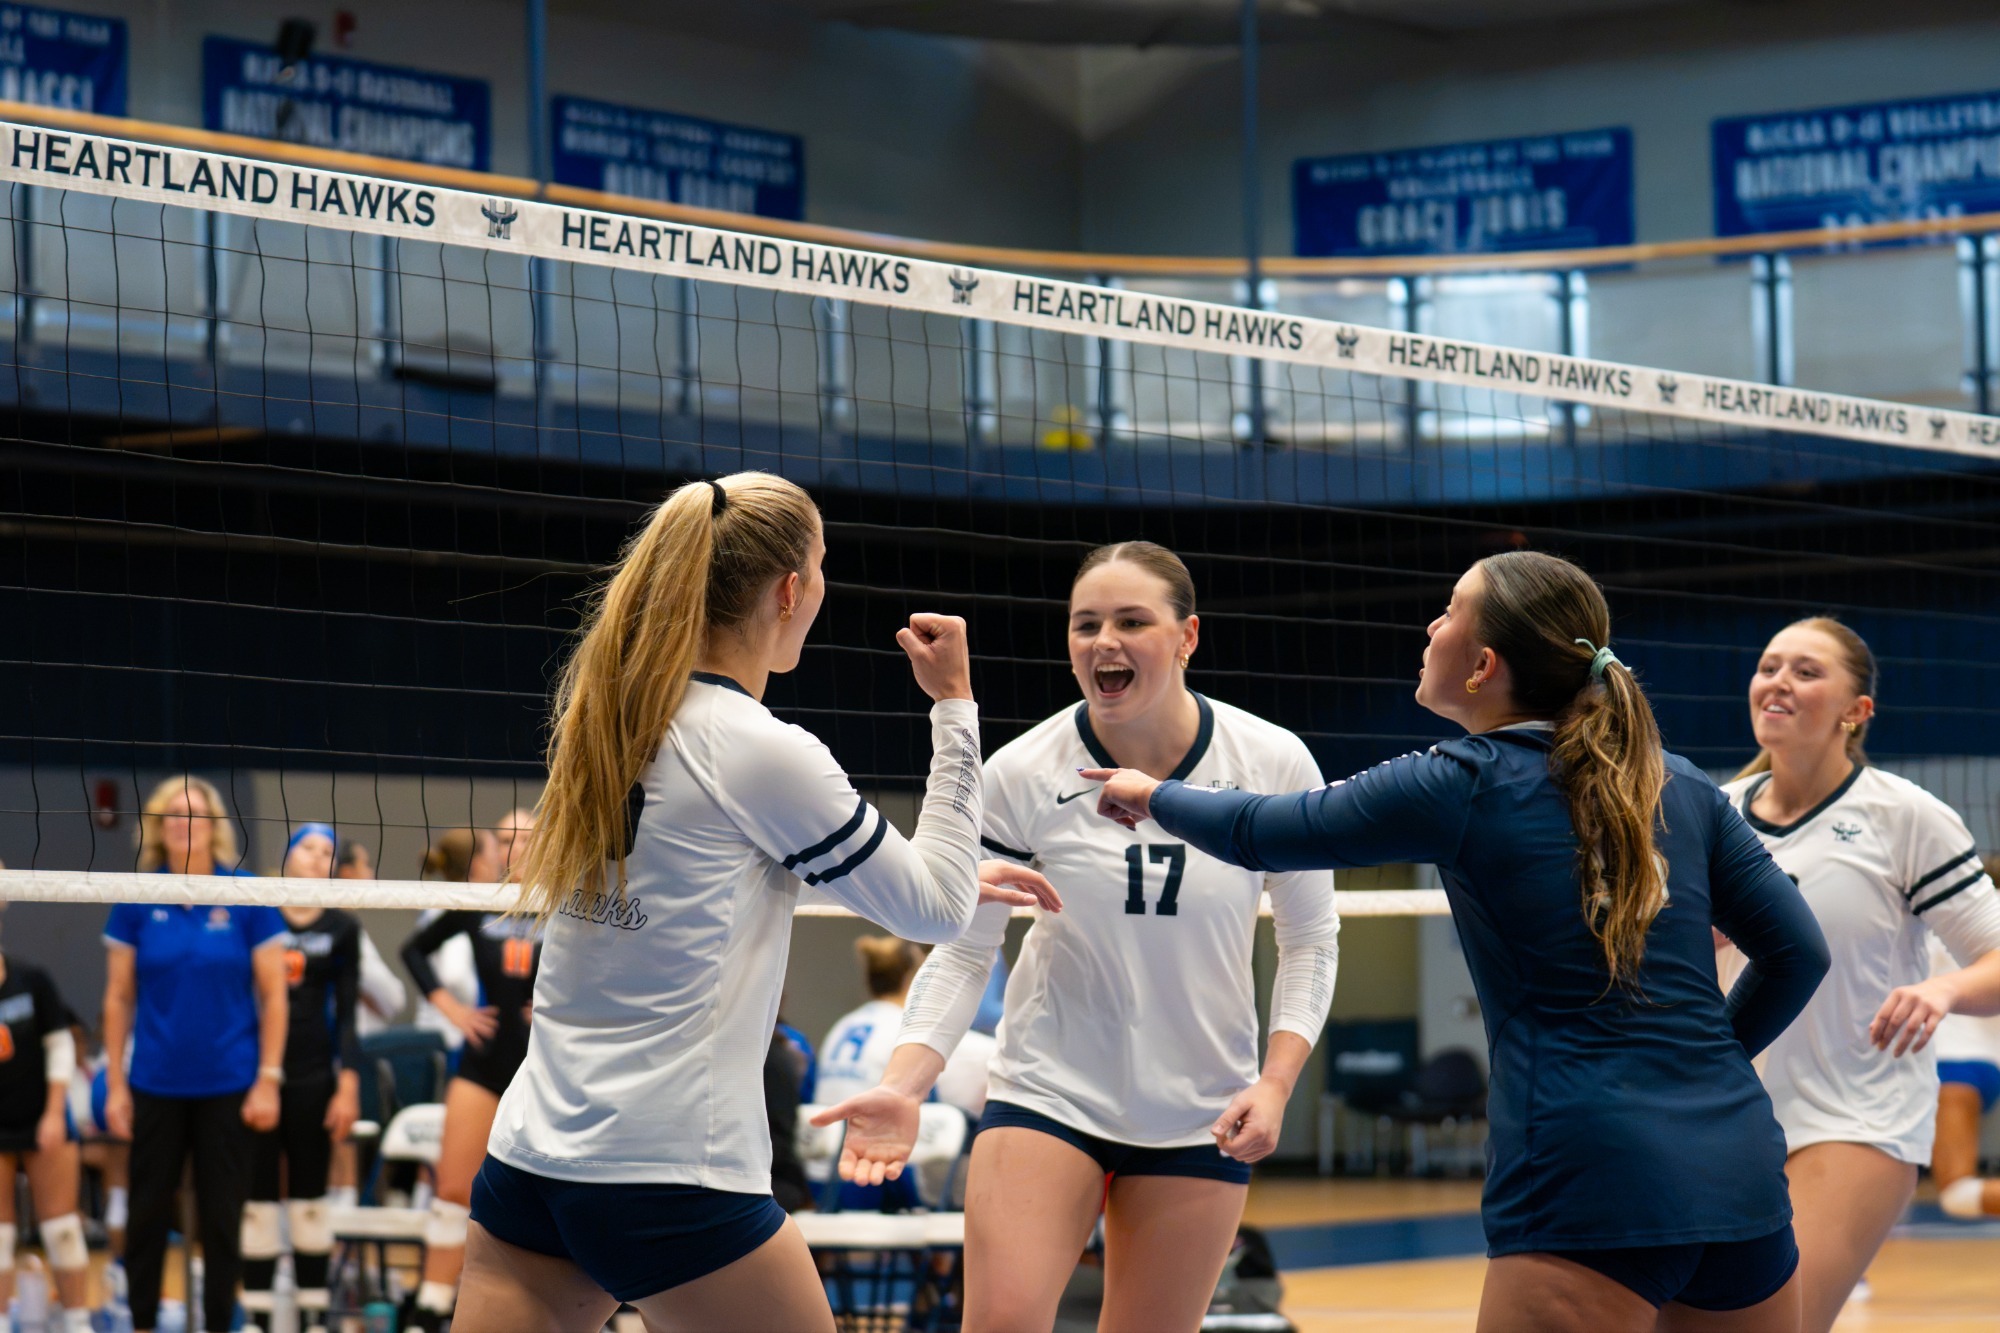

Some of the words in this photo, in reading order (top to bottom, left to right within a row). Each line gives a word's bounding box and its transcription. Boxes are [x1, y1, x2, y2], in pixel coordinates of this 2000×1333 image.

[10, 128, 279, 205] HEARTLAND
[290, 172, 437, 227] HAWKS
[561, 213, 782, 276] HEARTLAND
[791, 246, 911, 294] HAWKS
[1013, 280, 1196, 335] HEARTLAND
[1204, 308, 1304, 351] HAWKS
[1389, 336, 1540, 383] HEARTLAND
[1548, 358, 1632, 397] HAWKS
[1703, 382, 1831, 423] HEARTLAND
[1836, 401, 1909, 434] HAWKS
[1125, 843, 1187, 916] 17
